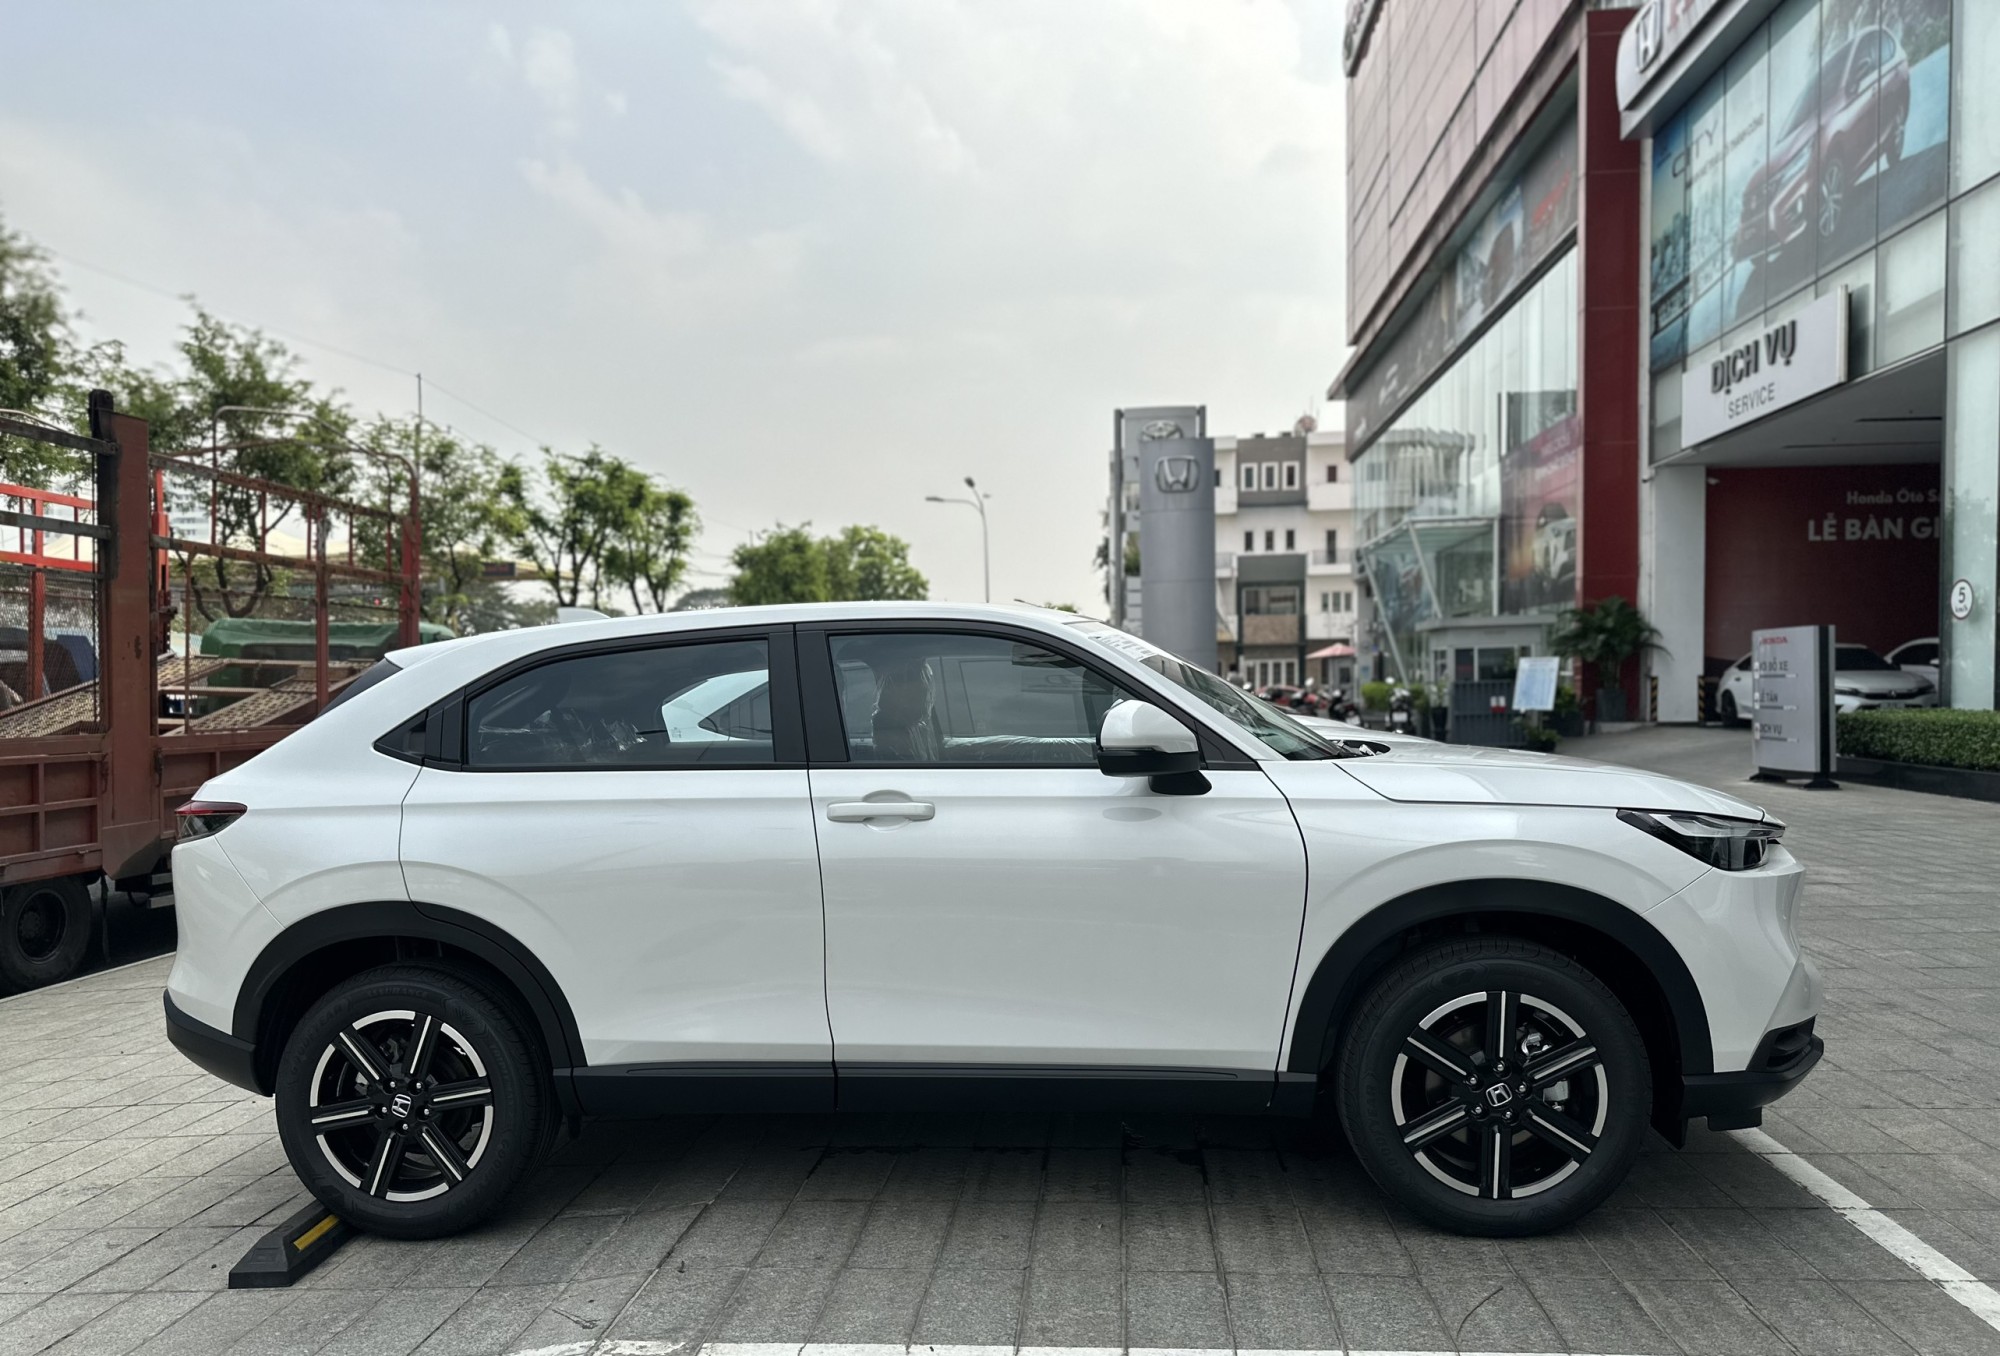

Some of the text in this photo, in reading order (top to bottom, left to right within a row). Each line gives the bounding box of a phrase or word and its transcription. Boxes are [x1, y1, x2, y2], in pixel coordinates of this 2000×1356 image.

[1711, 320, 1797, 395] DỊCH VỤ
[1728, 382, 1775, 419] SERVICE
[1846, 490, 1893, 505] Honda
[1927, 489, 1941, 503] S
[1845, 514, 1903, 540] BÀN
[1958, 587, 1966, 604] 5
